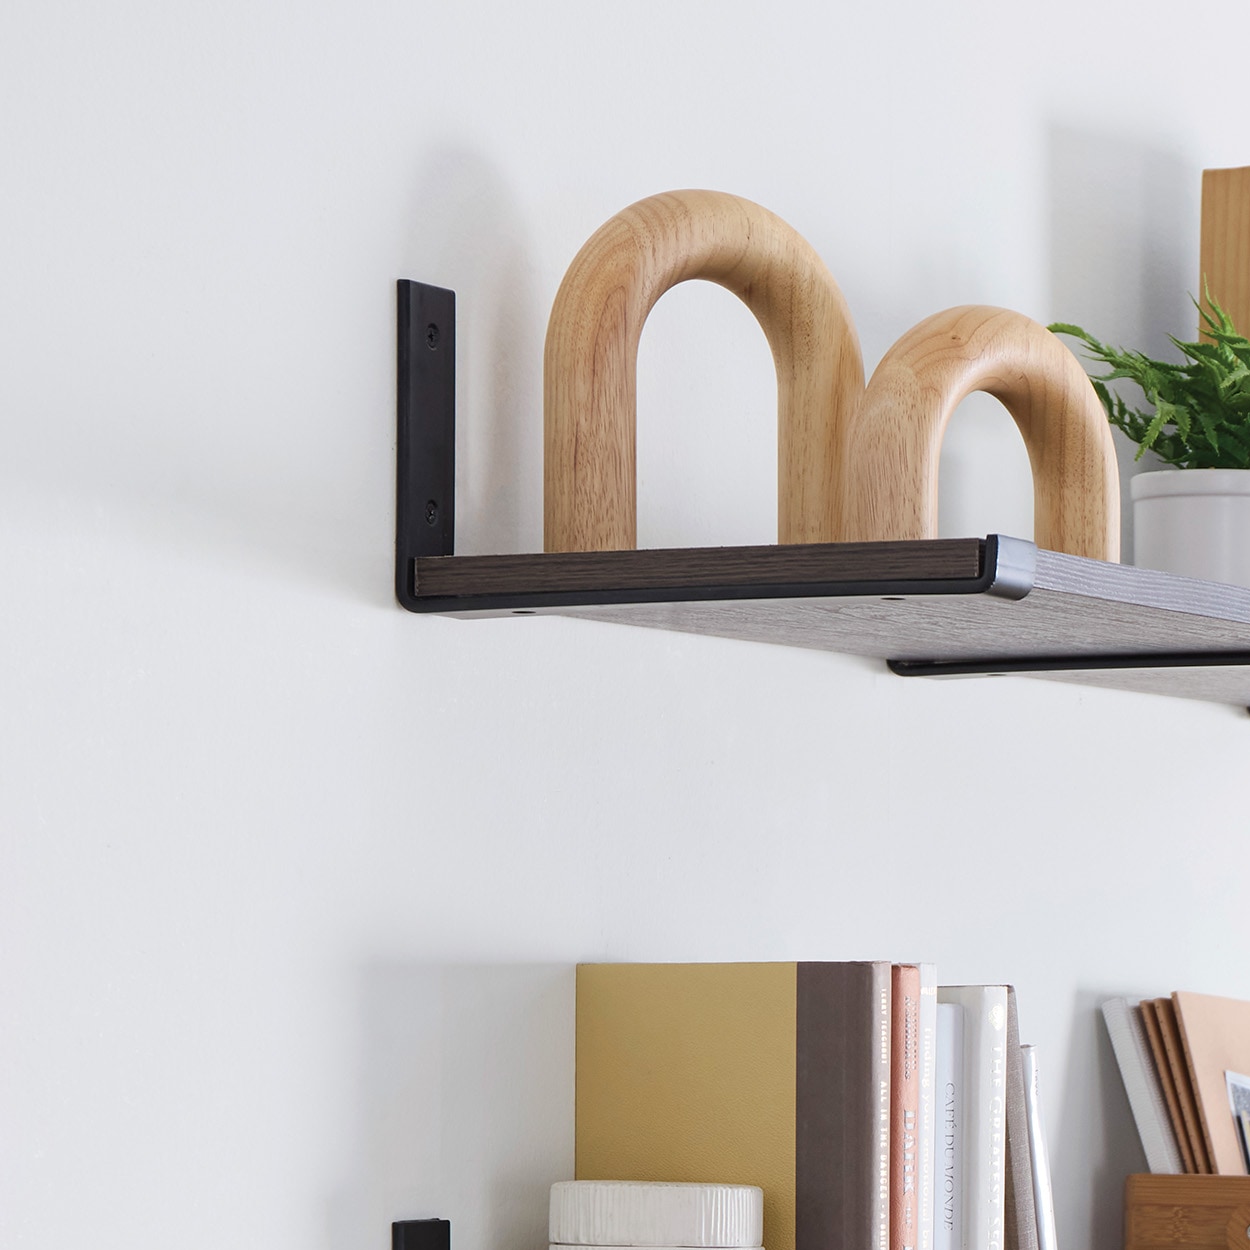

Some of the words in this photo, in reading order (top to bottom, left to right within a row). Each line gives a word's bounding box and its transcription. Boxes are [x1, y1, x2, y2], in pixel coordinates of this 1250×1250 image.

[921, 1027, 932, 1088] finding
[989, 1042, 1003, 1087] THE
[880, 1109, 887, 1121] IN
[921, 1094, 930, 1130] your
[944, 1081, 957, 1130] CAFÉ
[944, 1134, 954, 1160] DU
[922, 1138, 930, 1221] emotional
[943, 1164, 954, 1231] MONDE
